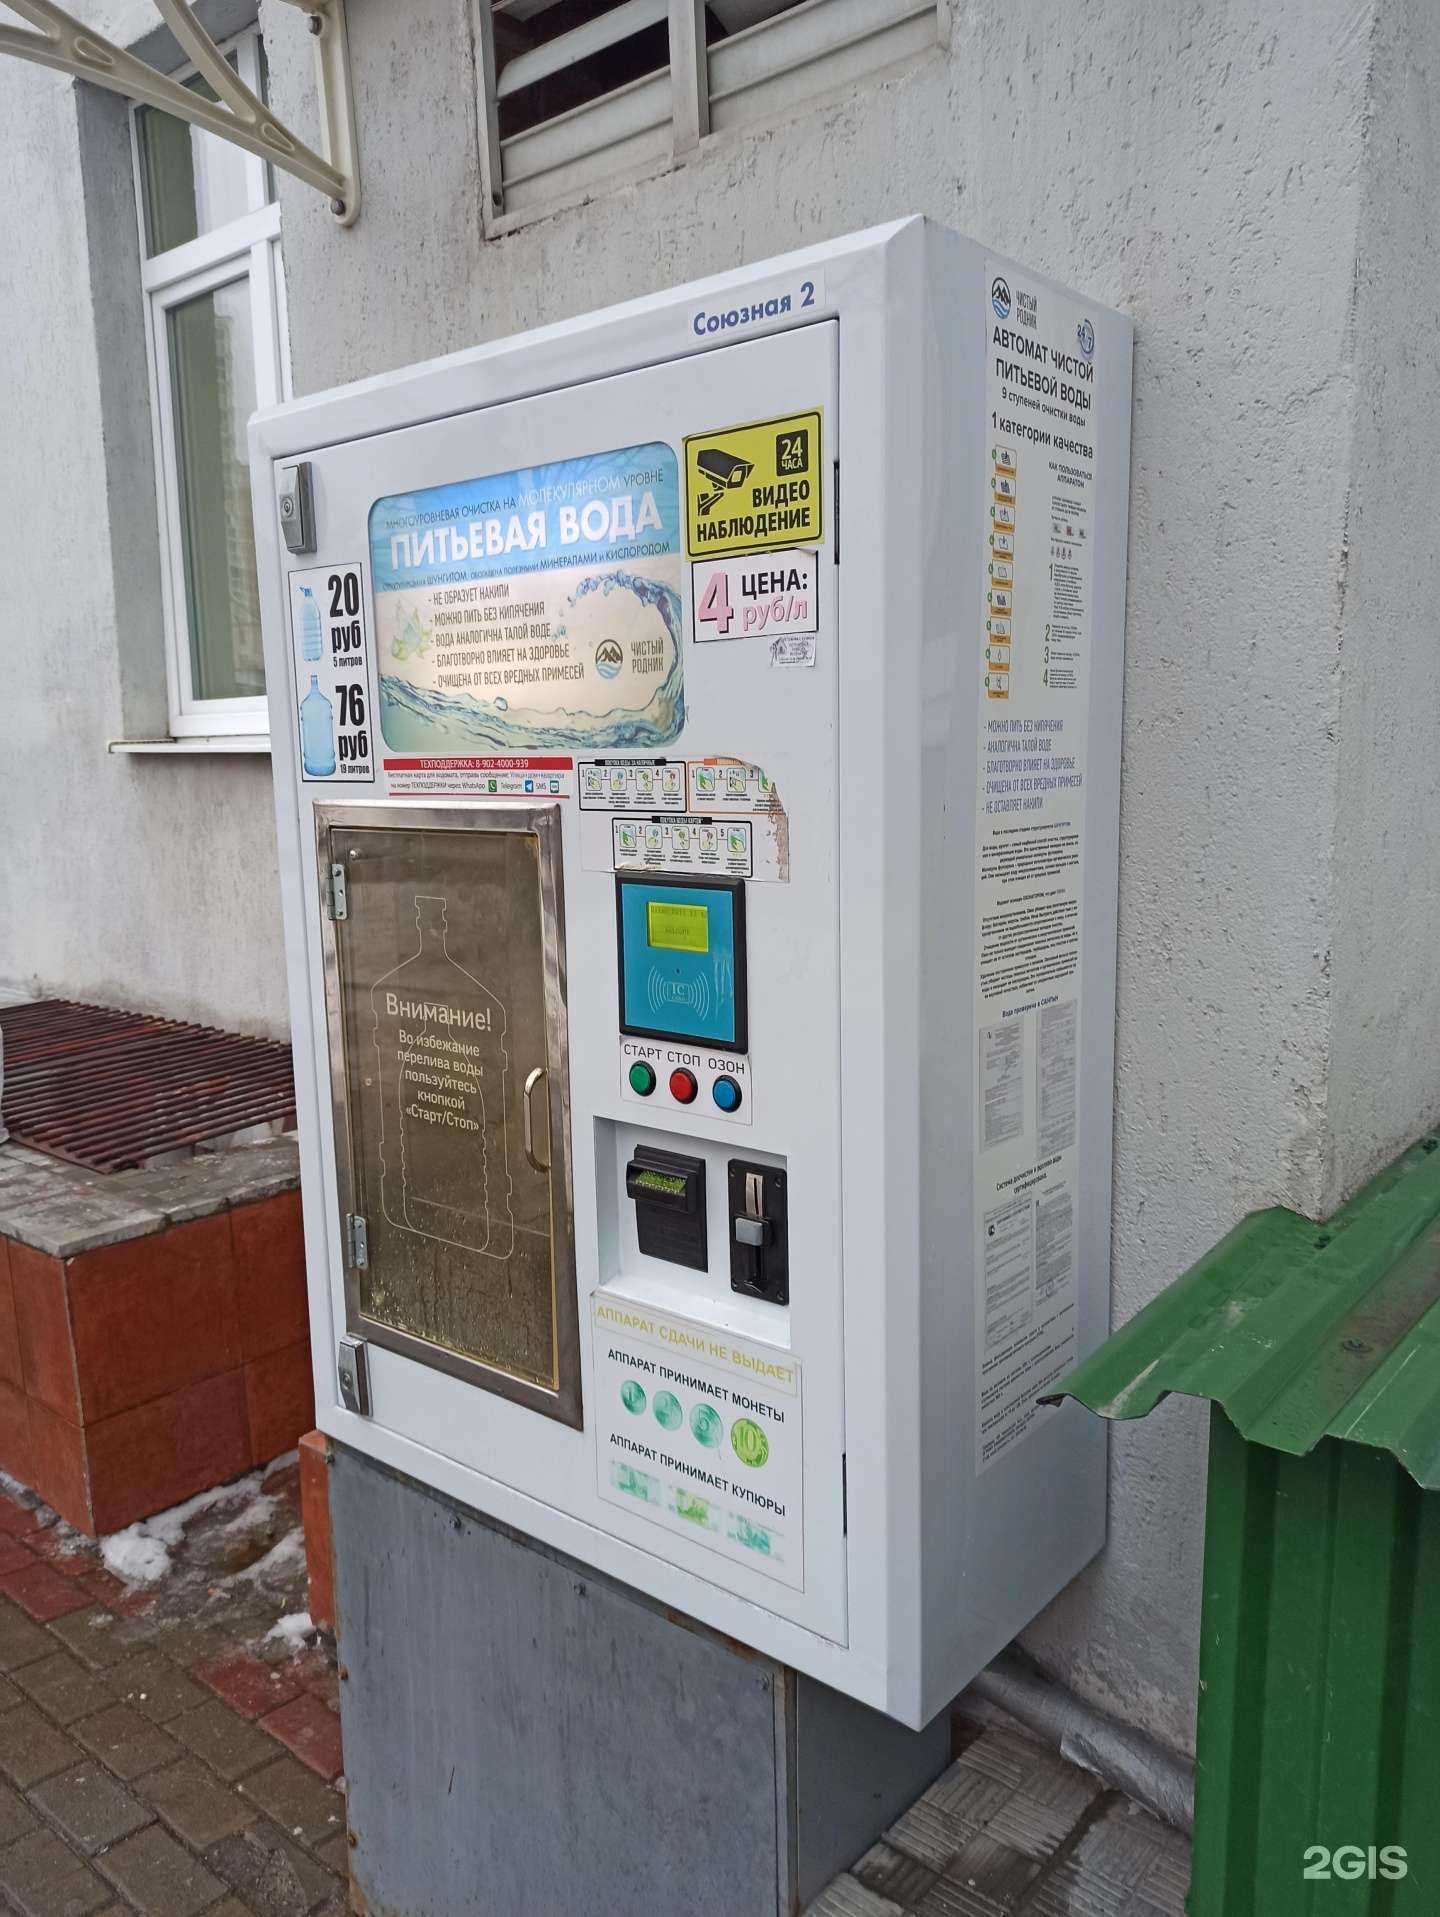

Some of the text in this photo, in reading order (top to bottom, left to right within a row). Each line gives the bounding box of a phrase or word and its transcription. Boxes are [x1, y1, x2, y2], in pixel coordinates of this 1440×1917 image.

[693, 281, 815, 335] Союзная 2
[993, 326, 1093, 383] АВТОМАТ ЧИСТОЙ
[996, 358, 1091, 411] ПИТЬЕВОЙ ВОДЫ
[1001, 386, 1086, 427] 9 ступеней очистки воды
[781, 437, 803, 460] 24
[992, 411, 1093, 459] 1 категории качества
[781, 459, 803, 471] ЧАСА
[386, 468, 664, 529] МНОГОУРОВНЕВАЯ ОЧИСТКА НА МОЛЕКУЛЯРНОМ УРОВНЕ
[752, 479, 810, 509] ВИДЕО
[390, 490, 663, 571] ПИТЬЕВАЯ ВОДА
[697, 507, 811, 542] НАБЛЮДЕНИЕ
[540, 552, 598, 569] МИНЕРАЛАМИ
[605, 541, 671, 561] КИСЛОРОДОМ
[327, 572, 360, 618] 20
[433, 583, 510, 606] НЕ ОБРАЗУЕТ НАКИПИ
[741, 568, 808, 600] ЦЕНА:
[434, 601, 545, 627] МОЖНО ПИТЬ БЕЗ КИПЯЧЕНИЯ
[698, 570, 808, 634] 4 руб/л
[331, 620, 362, 653] руб
[436, 623, 551, 648] ВОДА АНАЛОГИЧНА ТАЛОЙ ВОДЕ
[631, 637, 664, 657] ЧИСТЫЙ
[333, 656, 338, 668] 5
[437, 643, 570, 668] БЛАГОТВОРНО ВЛИЯЕТ НА ЗДОРОВЬЕ
[632, 657, 664, 675] РОДНИК
[438, 663, 585, 689] ОЧИЩЕНА ОТ ВСЕХ ВРЕДНЫХ ПРИМЕСЕЙ
[335, 684, 365, 727] 76
[338, 730, 368, 761] руб
[340, 764, 347, 774] 19
[420, 758, 529, 769] ТЕХПОДДЕРЖКА: 8-902-4000-939
[385, 992, 492, 1032] Внимание!
[399, 1030, 480, 1057] Во избежание
[397, 1050, 484, 1077] перелива воды
[624, 1044, 745, 1075] СТАРТ СТОП ОЗОН
[404, 1069, 477, 1095] пользуйтесь
[417, 1089, 465, 1111] кнопкой
[406, 1105, 479, 1131] «Старт/Стоп»
[595, 1304, 795, 1383] АППАРАТ СДАЧИ НЕ ВЫДАЕТ
[608, 1348, 785, 1423] АППАРАТ ПРИНИМАЕТ МОНЕТЫ
[610, 1433, 786, 1517] АППАРАТ ПРИНИМАЕТ КУПЮРЫ
